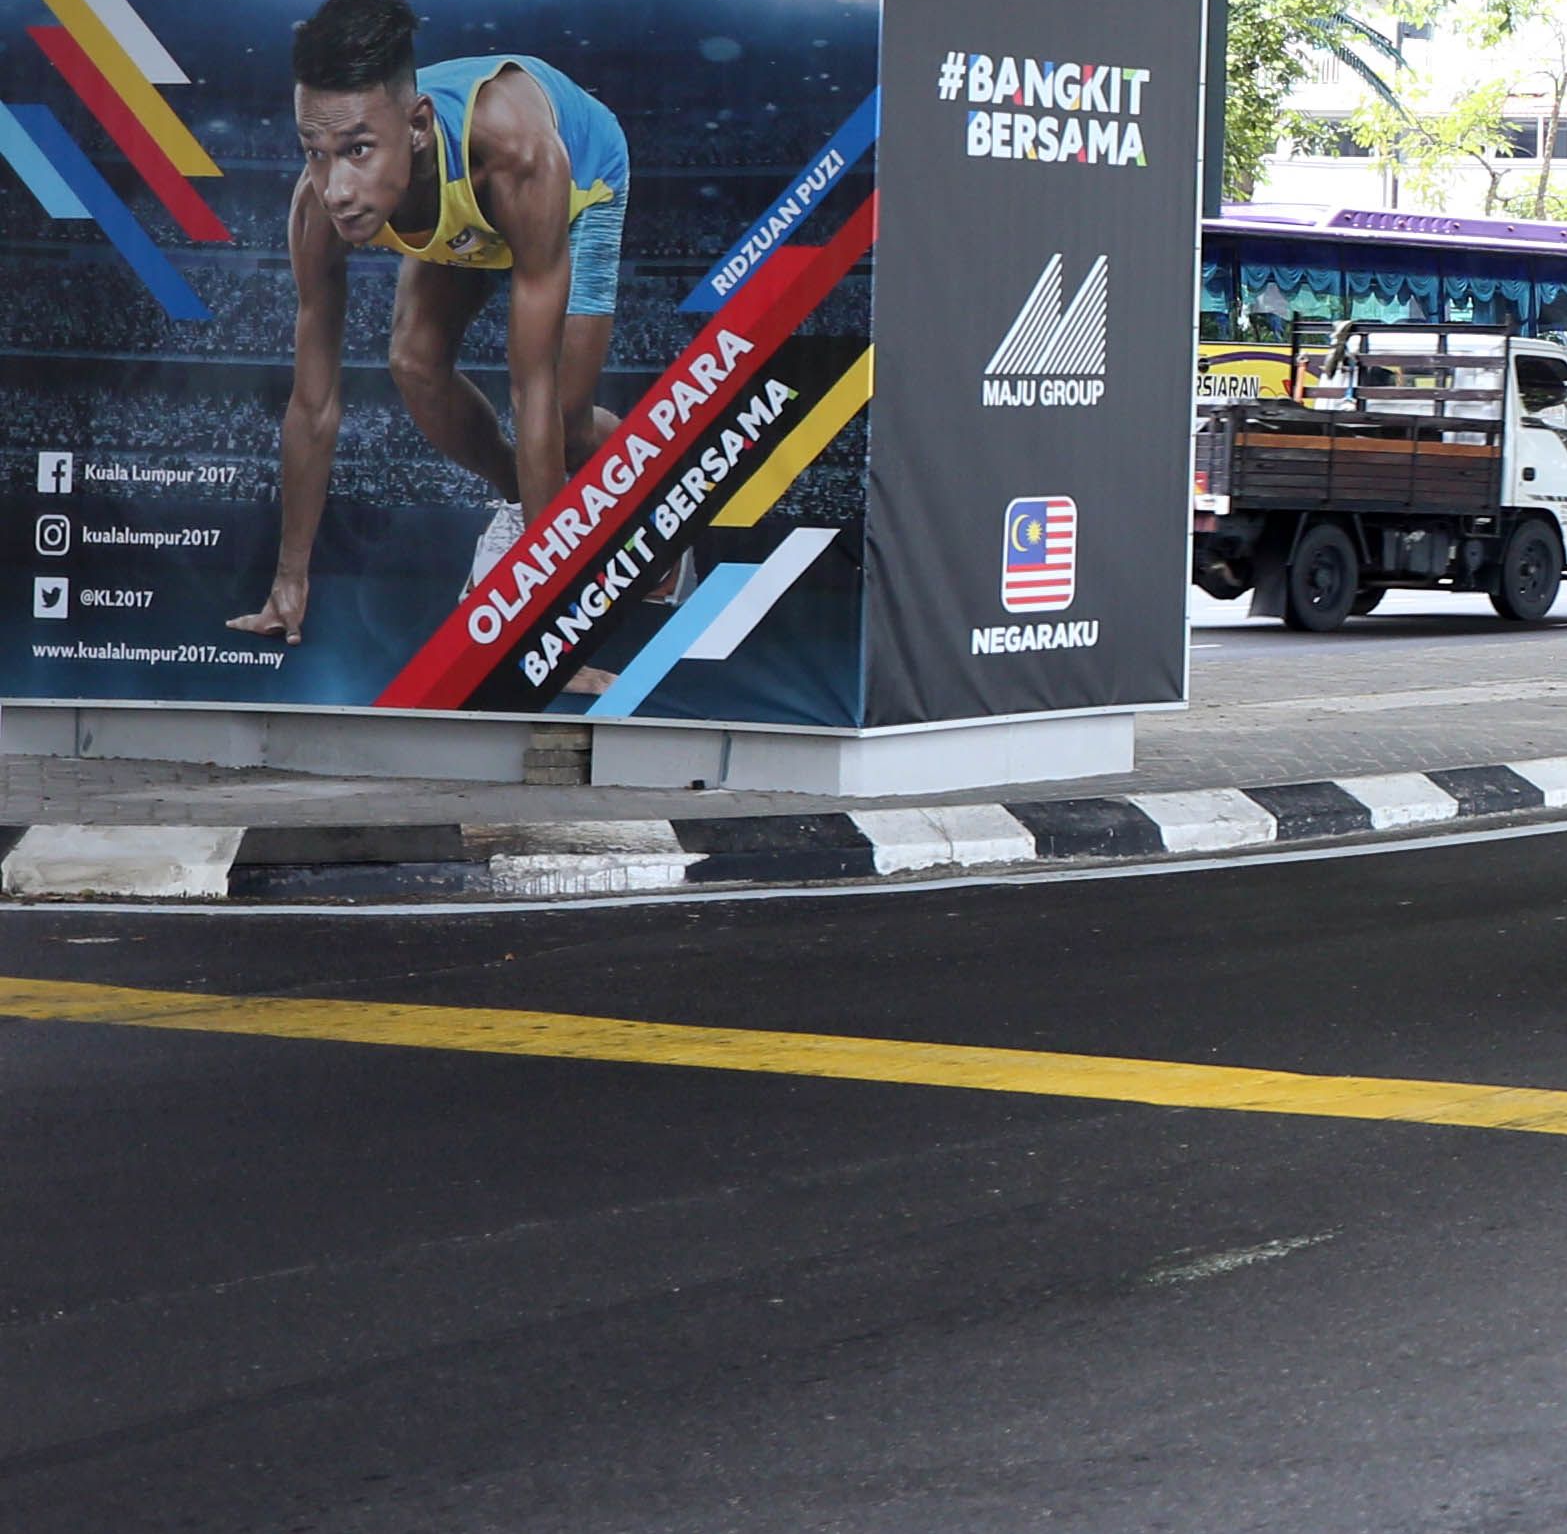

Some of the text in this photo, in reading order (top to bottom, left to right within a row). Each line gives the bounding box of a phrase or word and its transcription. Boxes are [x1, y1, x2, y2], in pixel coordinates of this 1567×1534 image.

[938, 51, 1151, 115] #BANGKIT
[967, 110, 1147, 167] BERSAMA
[710, 149, 845, 298] RIDZUAN PUZI
[982, 380, 1105, 407] MAJU GROUP
[84, 464, 237, 486] Kuala Lumpur 2017
[467, 328, 754, 644] OLAHRAGA PARA
[82, 526, 221, 549] kualalumpur2017
[519, 378, 799, 687] BANGKIT BERSAMA
[80, 589, 153, 608] @KL2017
[971, 620, 1099, 655] NEGARAKU
[32, 642, 284, 670] www.kualalumpur2017.com.my
